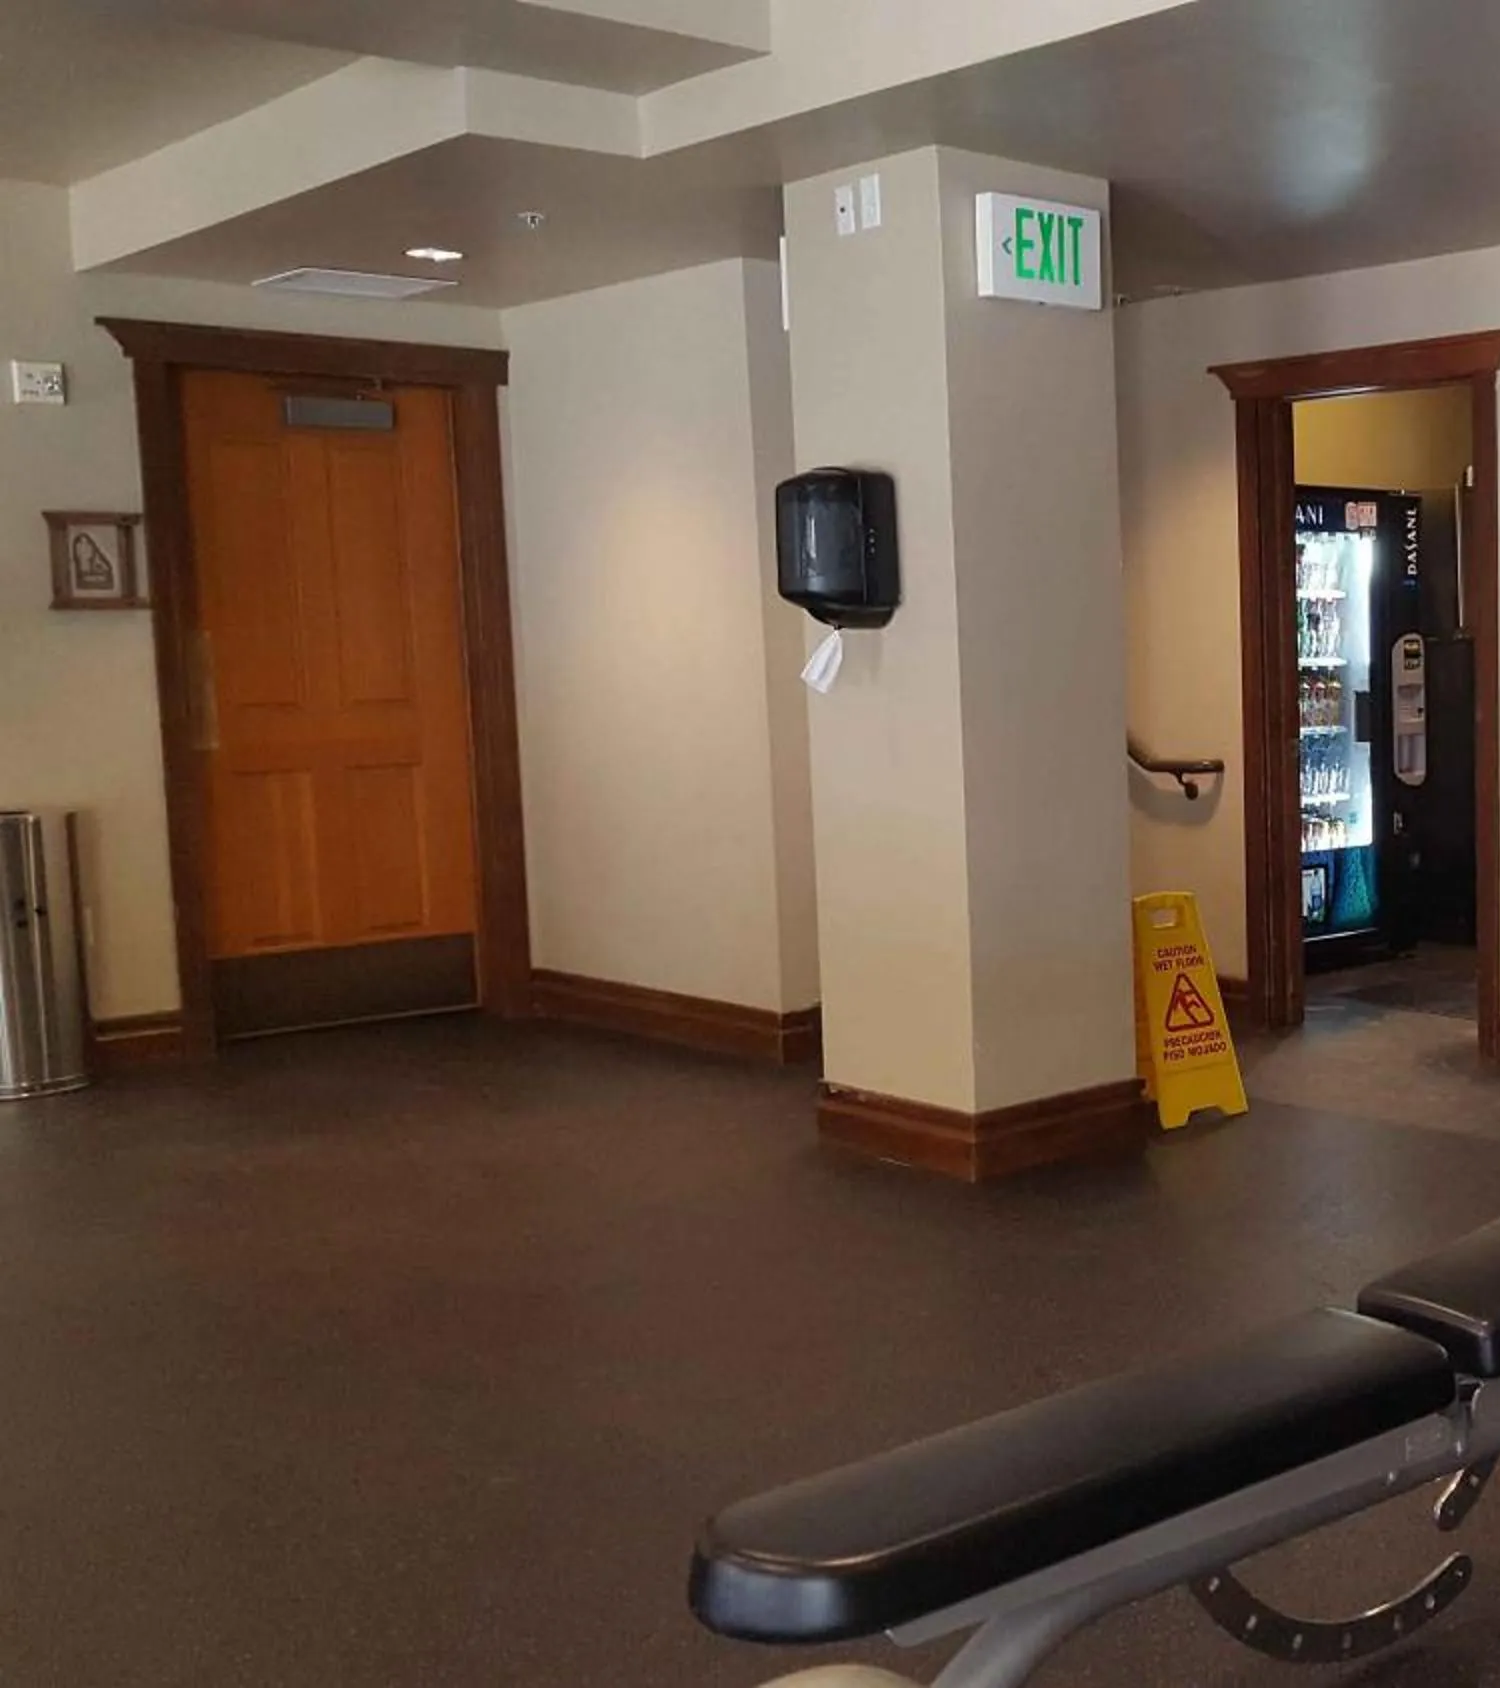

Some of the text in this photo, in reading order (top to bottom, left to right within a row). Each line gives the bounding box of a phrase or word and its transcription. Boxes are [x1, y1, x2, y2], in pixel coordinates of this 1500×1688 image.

[1015, 207, 1085, 286] EXIT
[1405, 506, 1418, 575] DASANI
[1157, 944, 1197, 959] CAUTION
[1152, 954, 1205, 973] WET FLOOR
[1163, 1041, 1227, 1063] PISO MOJADO
